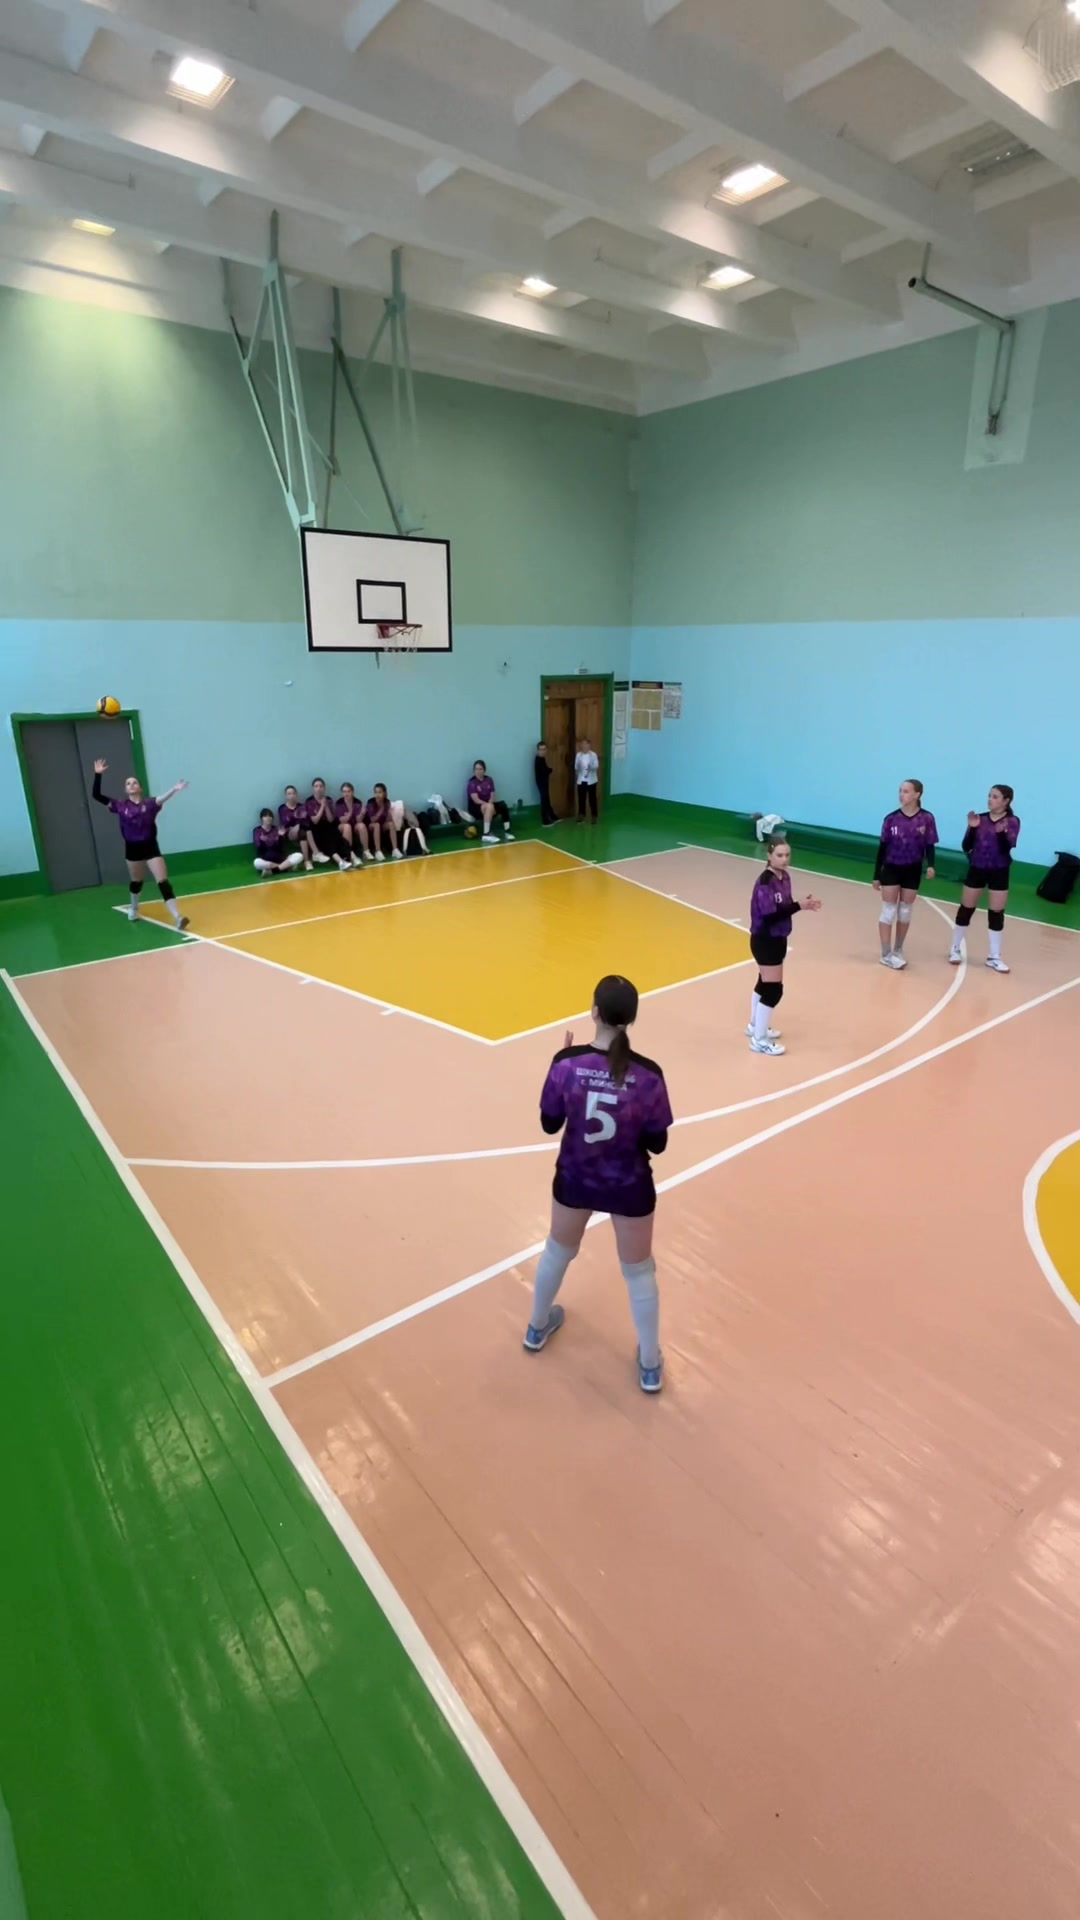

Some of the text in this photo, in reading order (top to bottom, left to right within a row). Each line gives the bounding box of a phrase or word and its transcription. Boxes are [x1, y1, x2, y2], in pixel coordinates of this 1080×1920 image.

[576, 1067, 610, 1079] ШКОЛА
[589, 1078, 628, 1091] МИНСА
[584, 1091, 618, 1144] 5
